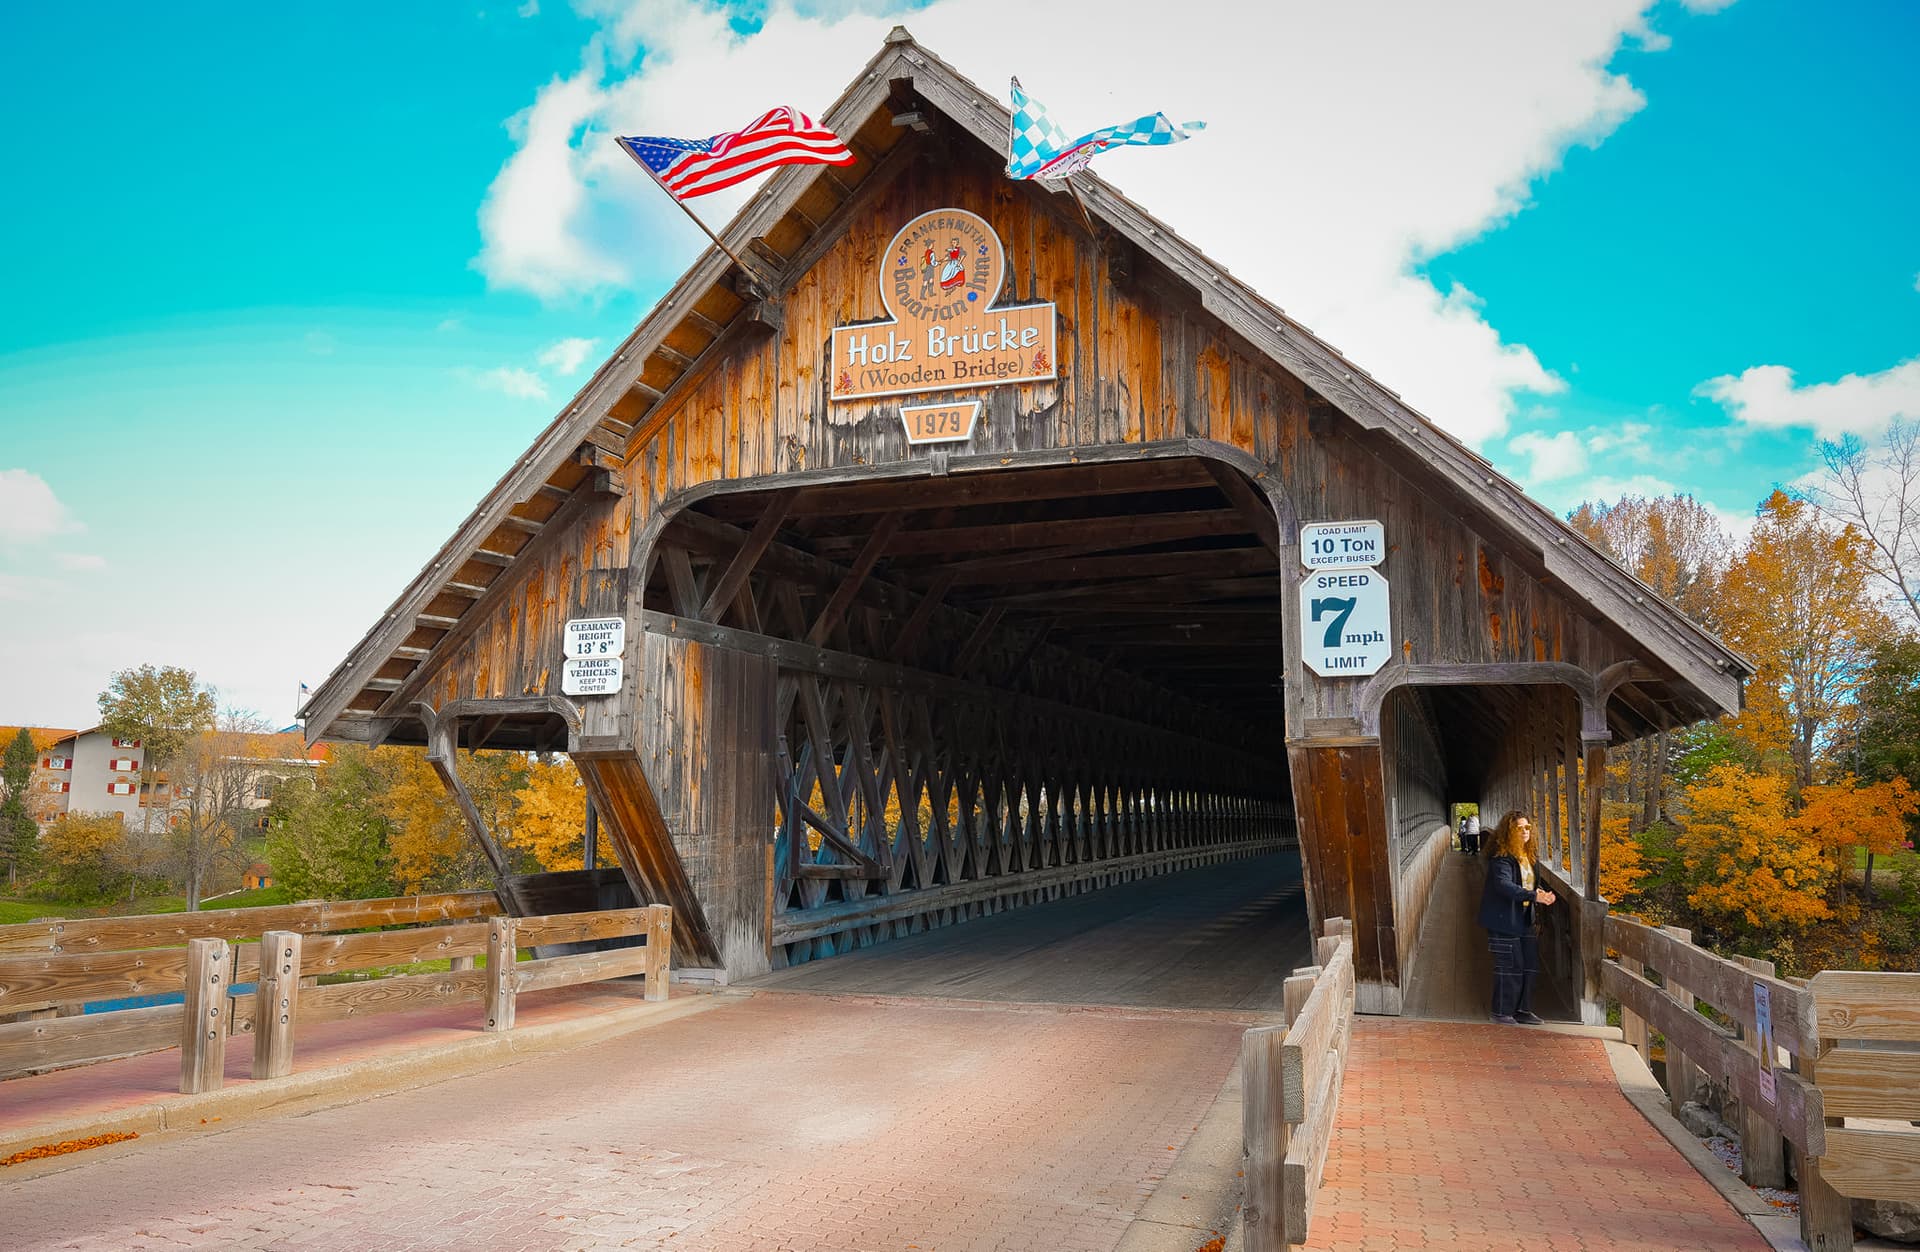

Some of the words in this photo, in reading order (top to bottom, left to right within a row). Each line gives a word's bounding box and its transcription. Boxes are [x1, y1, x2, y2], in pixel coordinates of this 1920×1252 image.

[899, 218, 986, 255] FRANKENMUTH
[893, 266, 968, 322] Bavarian
[965, 256, 991, 292] Inn
[848, 331, 913, 367] Holz
[927, 318, 1040, 359] Brücke
[859, 365, 946, 390] (Wooden
[952, 354, 1025, 379] Bridge)
[915, 411, 961, 436] 1979
[1317, 527, 1341, 536] LOAD
[1343, 526, 1368, 534] LIMIT
[1311, 538, 1335, 554] 10
[1310, 556, 1344, 565] EXCEPT
[1346, 554, 1376, 563] BUSES
[1317, 575, 1370, 589] SPEED
[570, 622, 622, 632] CLEARANCE
[1311, 597, 1357, 649] 7
[1345, 630, 1385, 646] mph
[578, 632, 612, 641] HEIGHT
[577, 641, 596, 654] 13'
[578, 660, 610, 668] LARGE
[1325, 656, 1369, 669] LIMIT
[570, 668, 617, 678] VEHICLES
